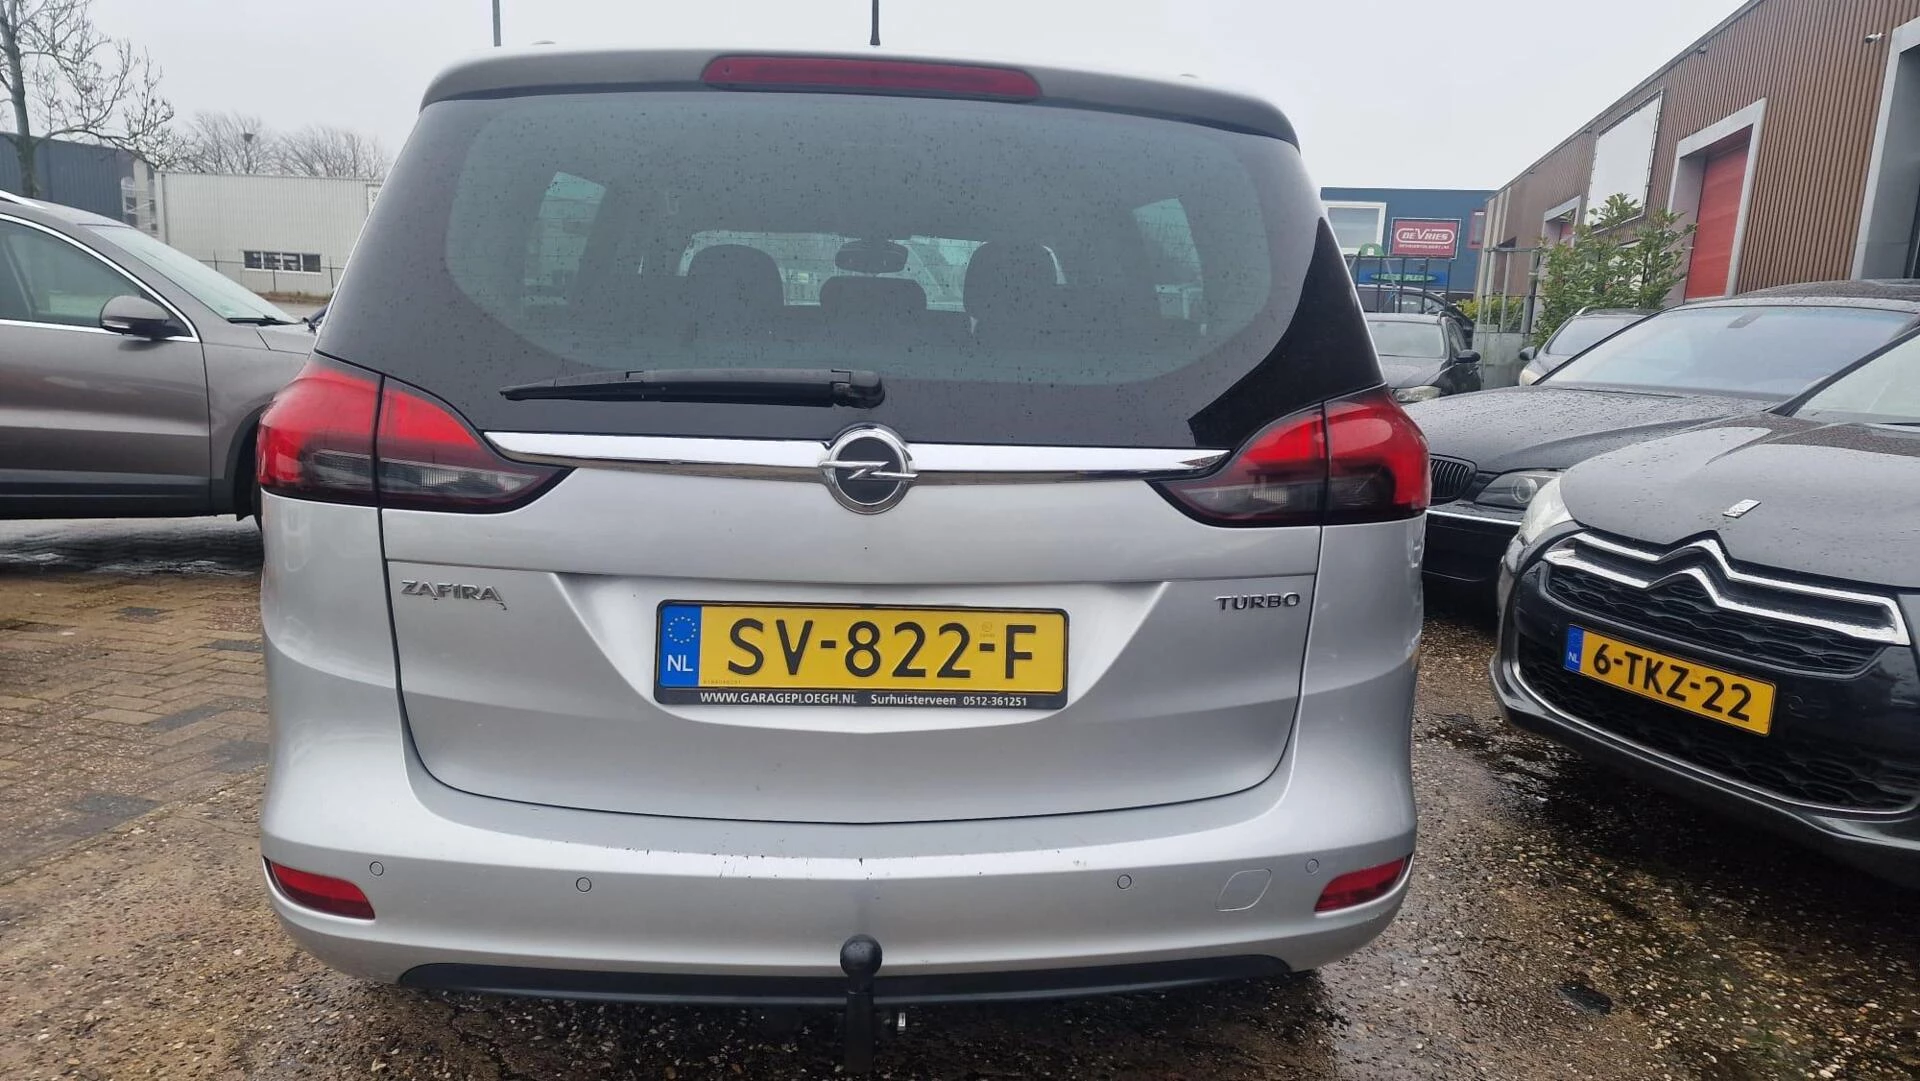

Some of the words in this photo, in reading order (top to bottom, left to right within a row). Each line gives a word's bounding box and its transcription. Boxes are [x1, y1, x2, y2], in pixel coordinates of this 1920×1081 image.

[401, 580, 508, 609] ZAFIRA
[1215, 592, 1300, 610] TURBO
[727, 617, 1037, 680] SV-822-F
[1568, 651, 1579, 664] NL
[667, 654, 693, 672] NL
[1593, 643, 1752, 722] 6-TKZ-22
[700, 691, 857, 704] WWW.GARAGEPLOEGH.NL
[870, 693, 957, 705] Surhuisterveen
[963, 695, 1027, 707] 0512-361251
